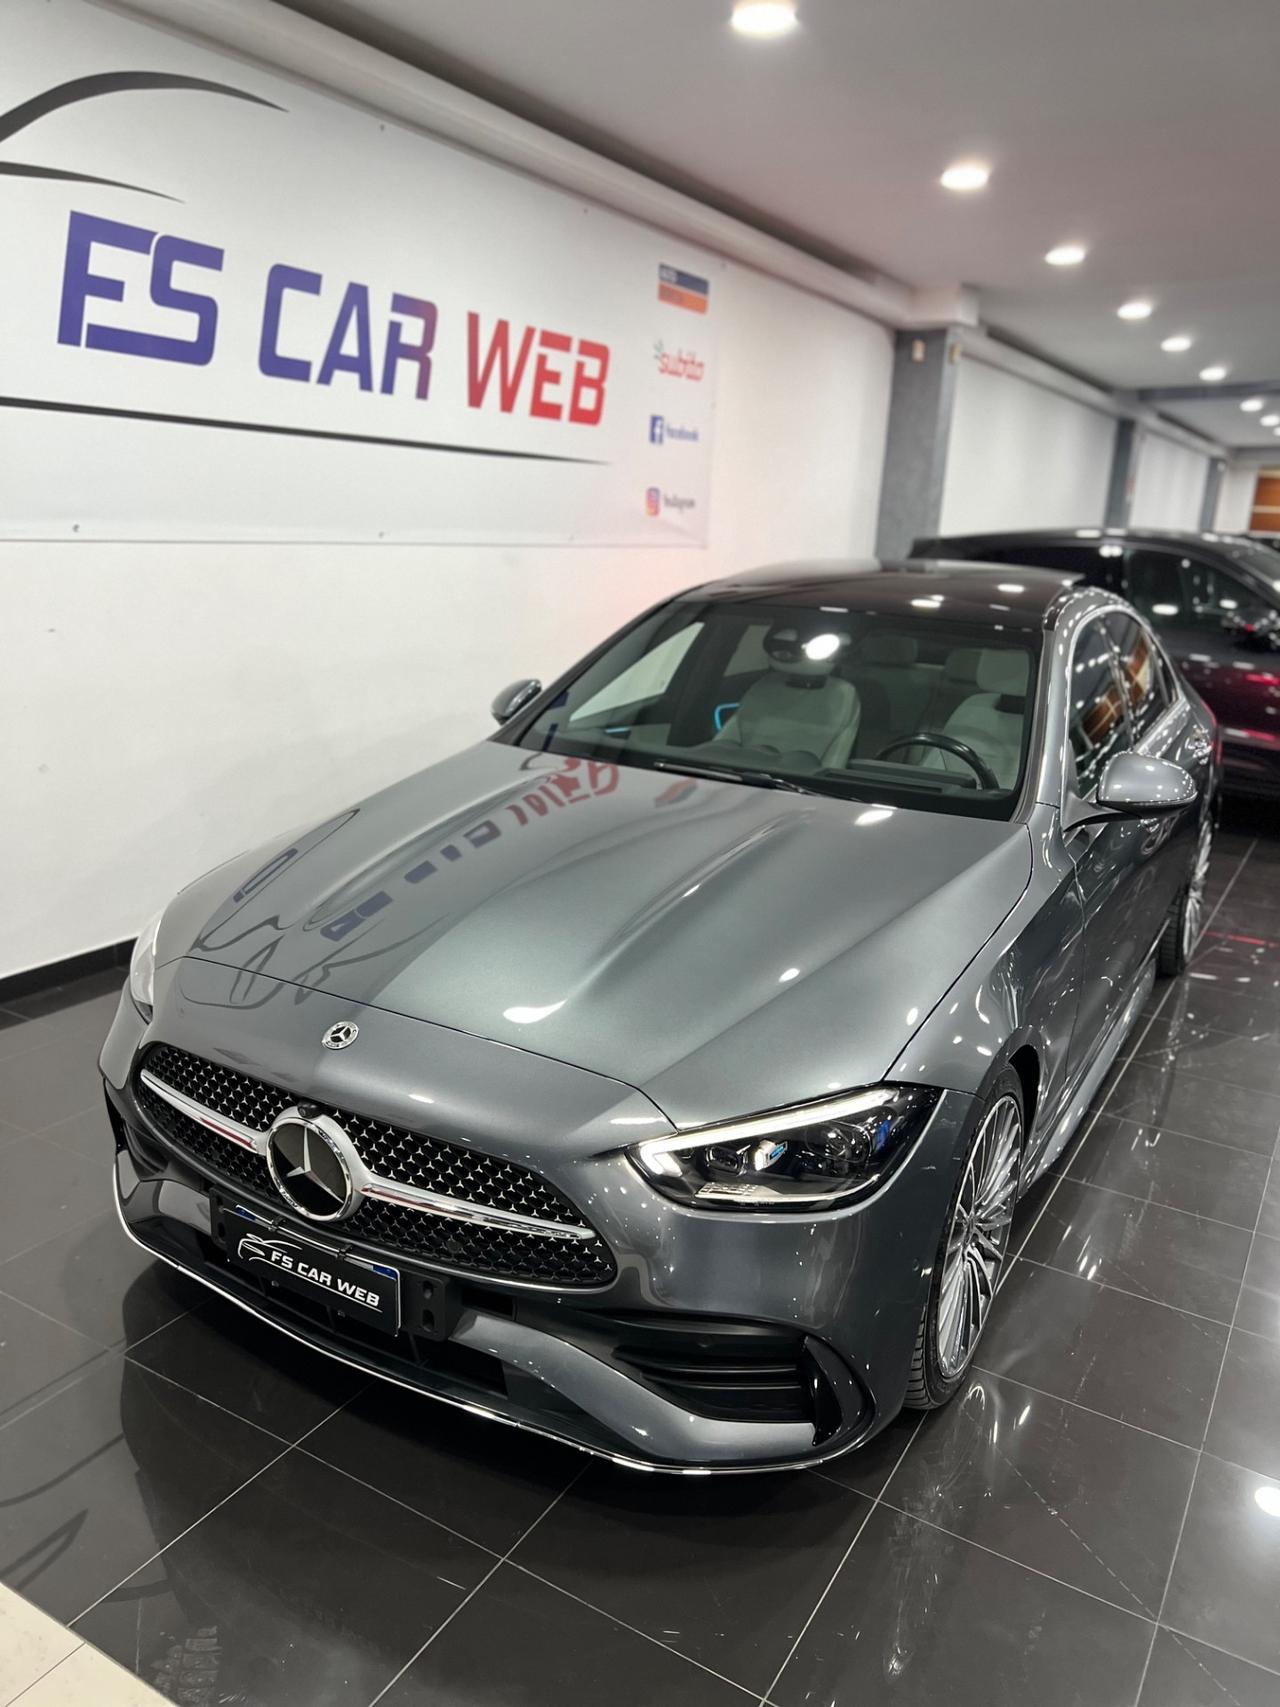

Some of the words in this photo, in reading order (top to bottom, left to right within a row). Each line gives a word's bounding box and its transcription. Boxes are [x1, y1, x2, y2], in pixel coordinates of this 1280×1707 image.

[58, 211, 224, 366] FS
[259, 264, 438, 400] CAR
[467, 311, 610, 426] WEB
[271, 1250, 294, 1270] FS
[297, 1262, 332, 1287] CAR
[337, 1278, 380, 1307] WEB
